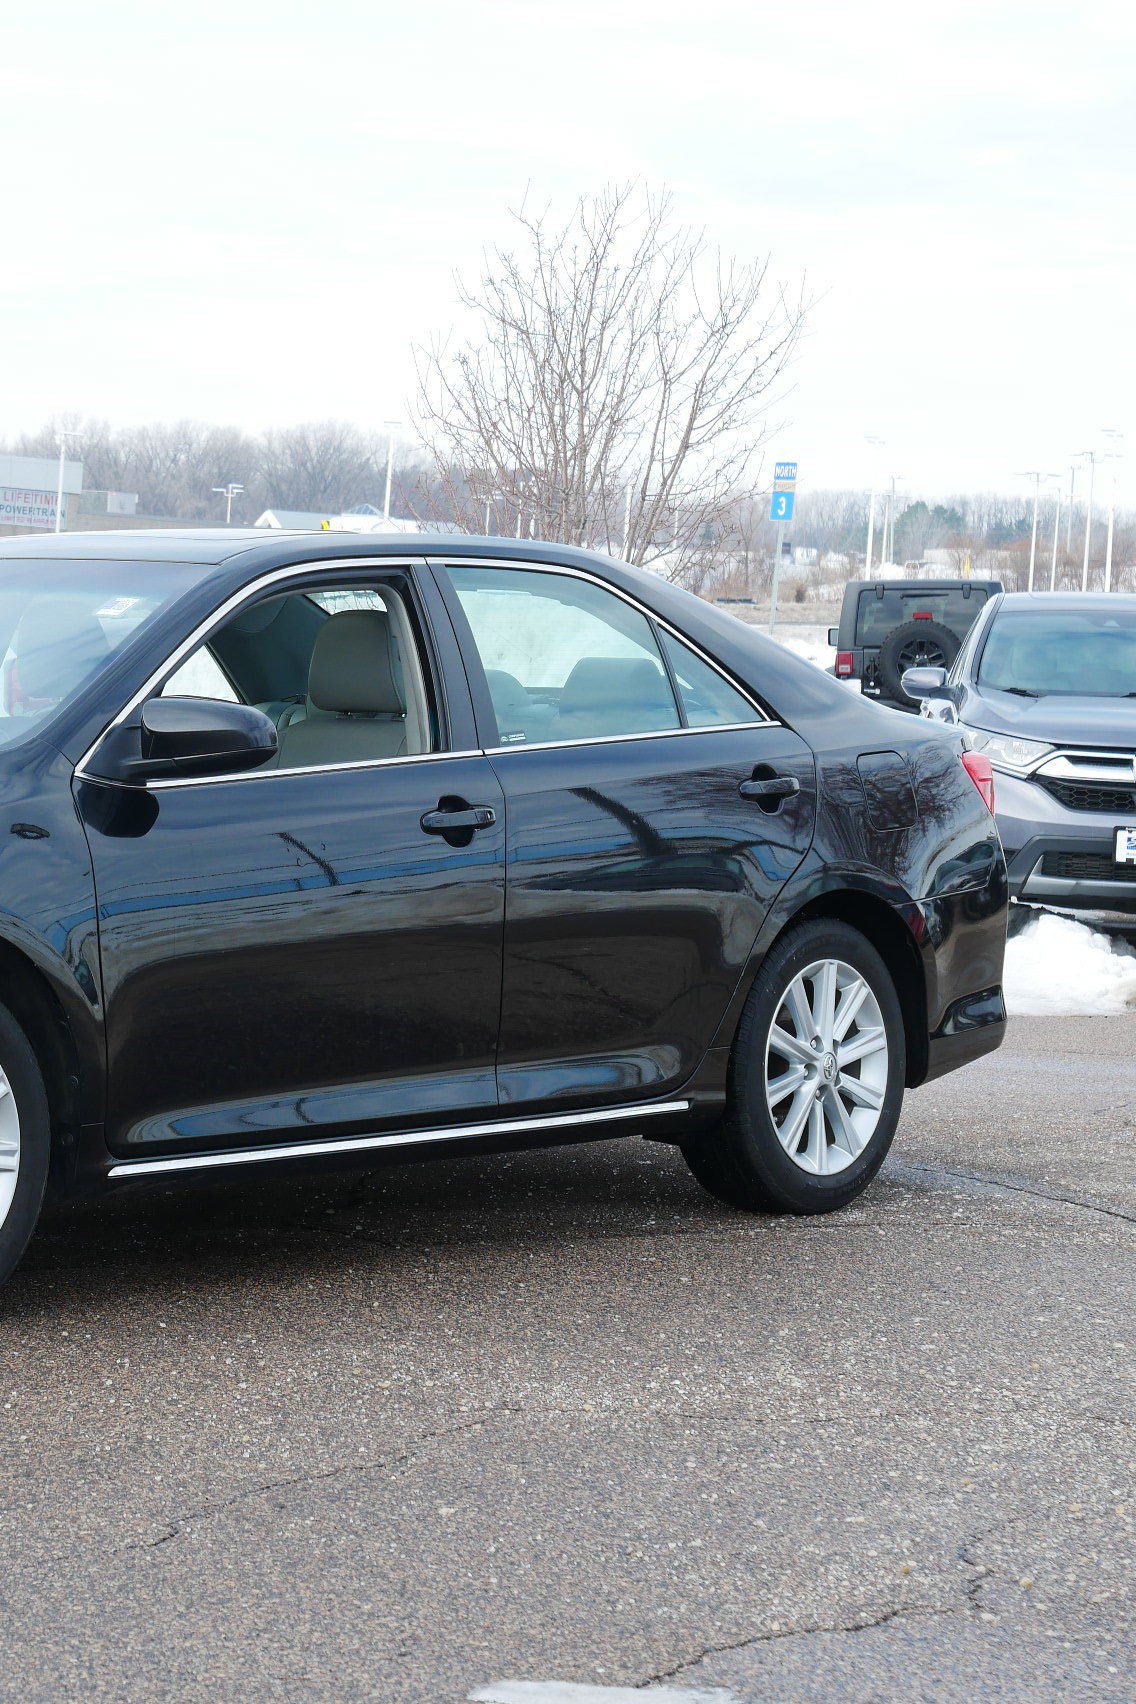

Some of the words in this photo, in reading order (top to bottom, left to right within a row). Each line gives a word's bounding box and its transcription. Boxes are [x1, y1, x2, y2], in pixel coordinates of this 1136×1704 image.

[776, 465, 797, 477] NORTH
[0, 504, 66, 518] POWERTRAN
[777, 496, 786, 516] 3
